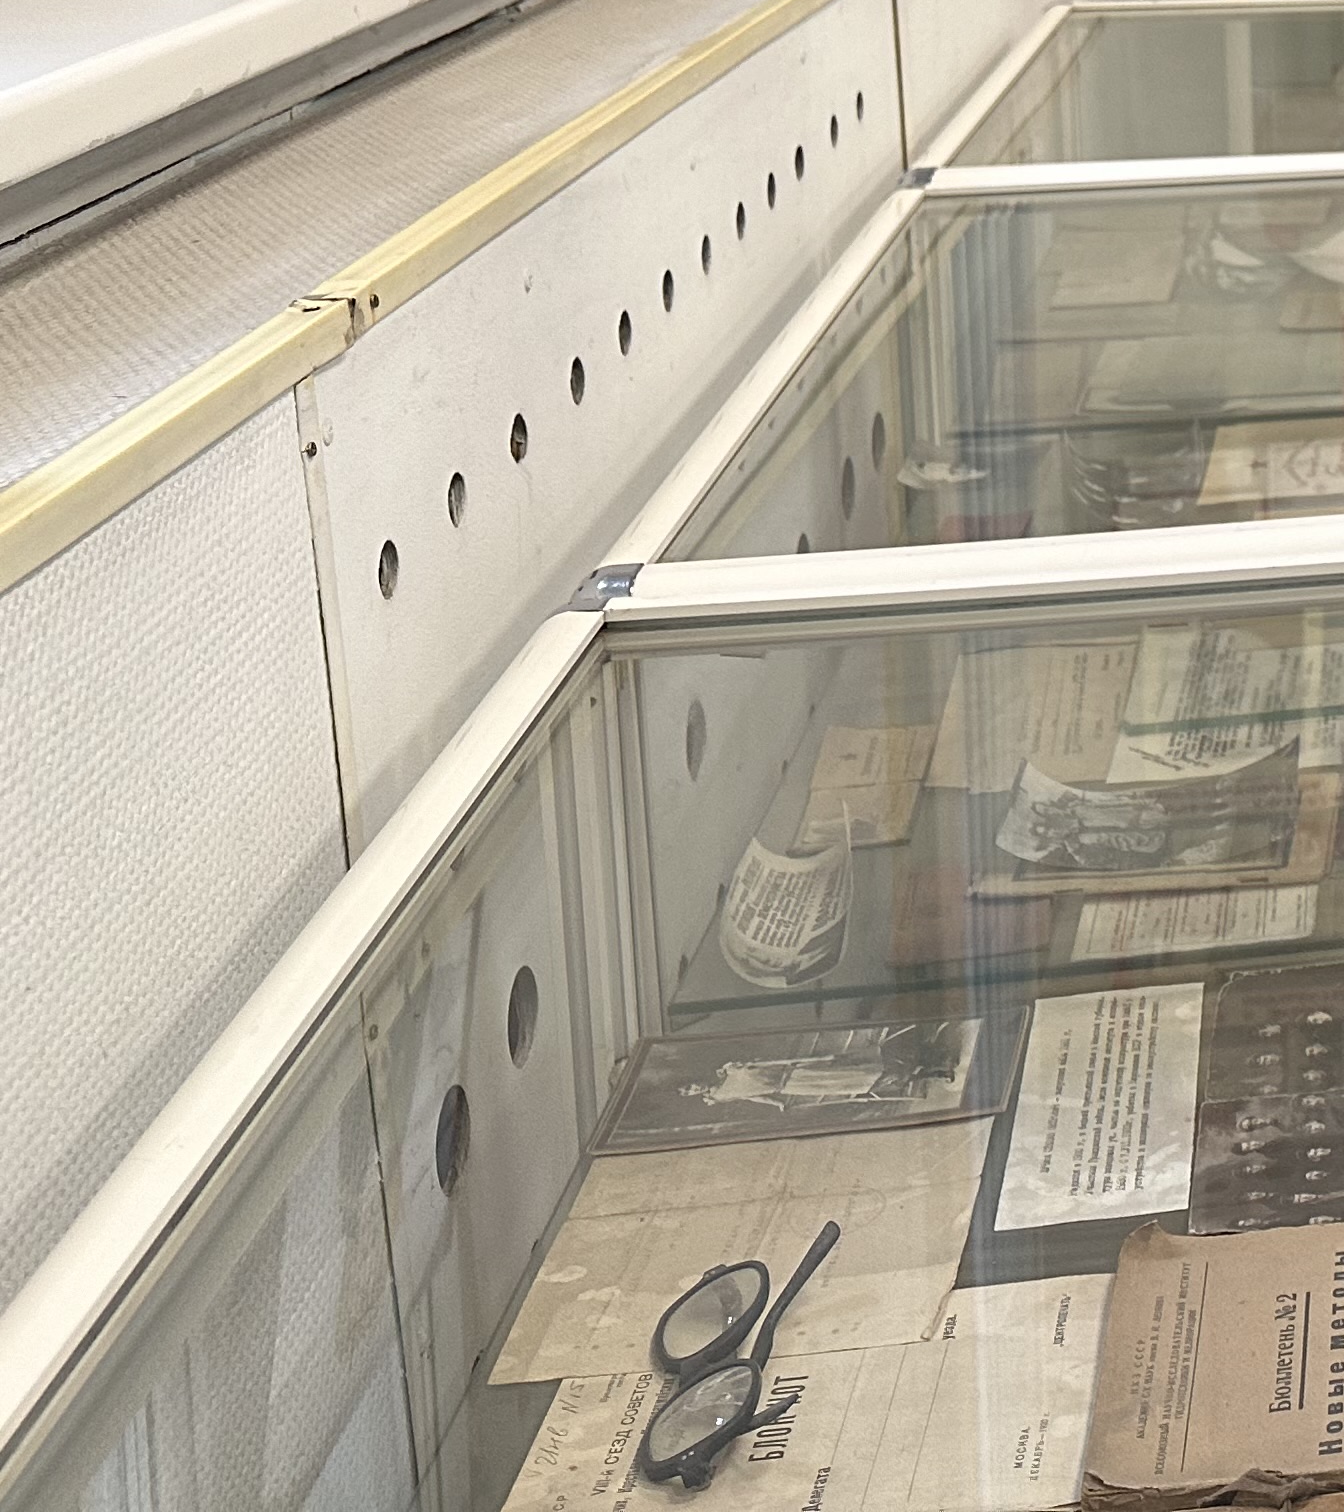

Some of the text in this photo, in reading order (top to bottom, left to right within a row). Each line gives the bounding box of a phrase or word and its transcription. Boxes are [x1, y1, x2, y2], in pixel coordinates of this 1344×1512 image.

[1133, 1339, 1145, 1368] СССР
[1268, 1292, 1297, 1413] Бюллетень № 2
[622, 1373, 653, 1424] СОВЕТОВ
